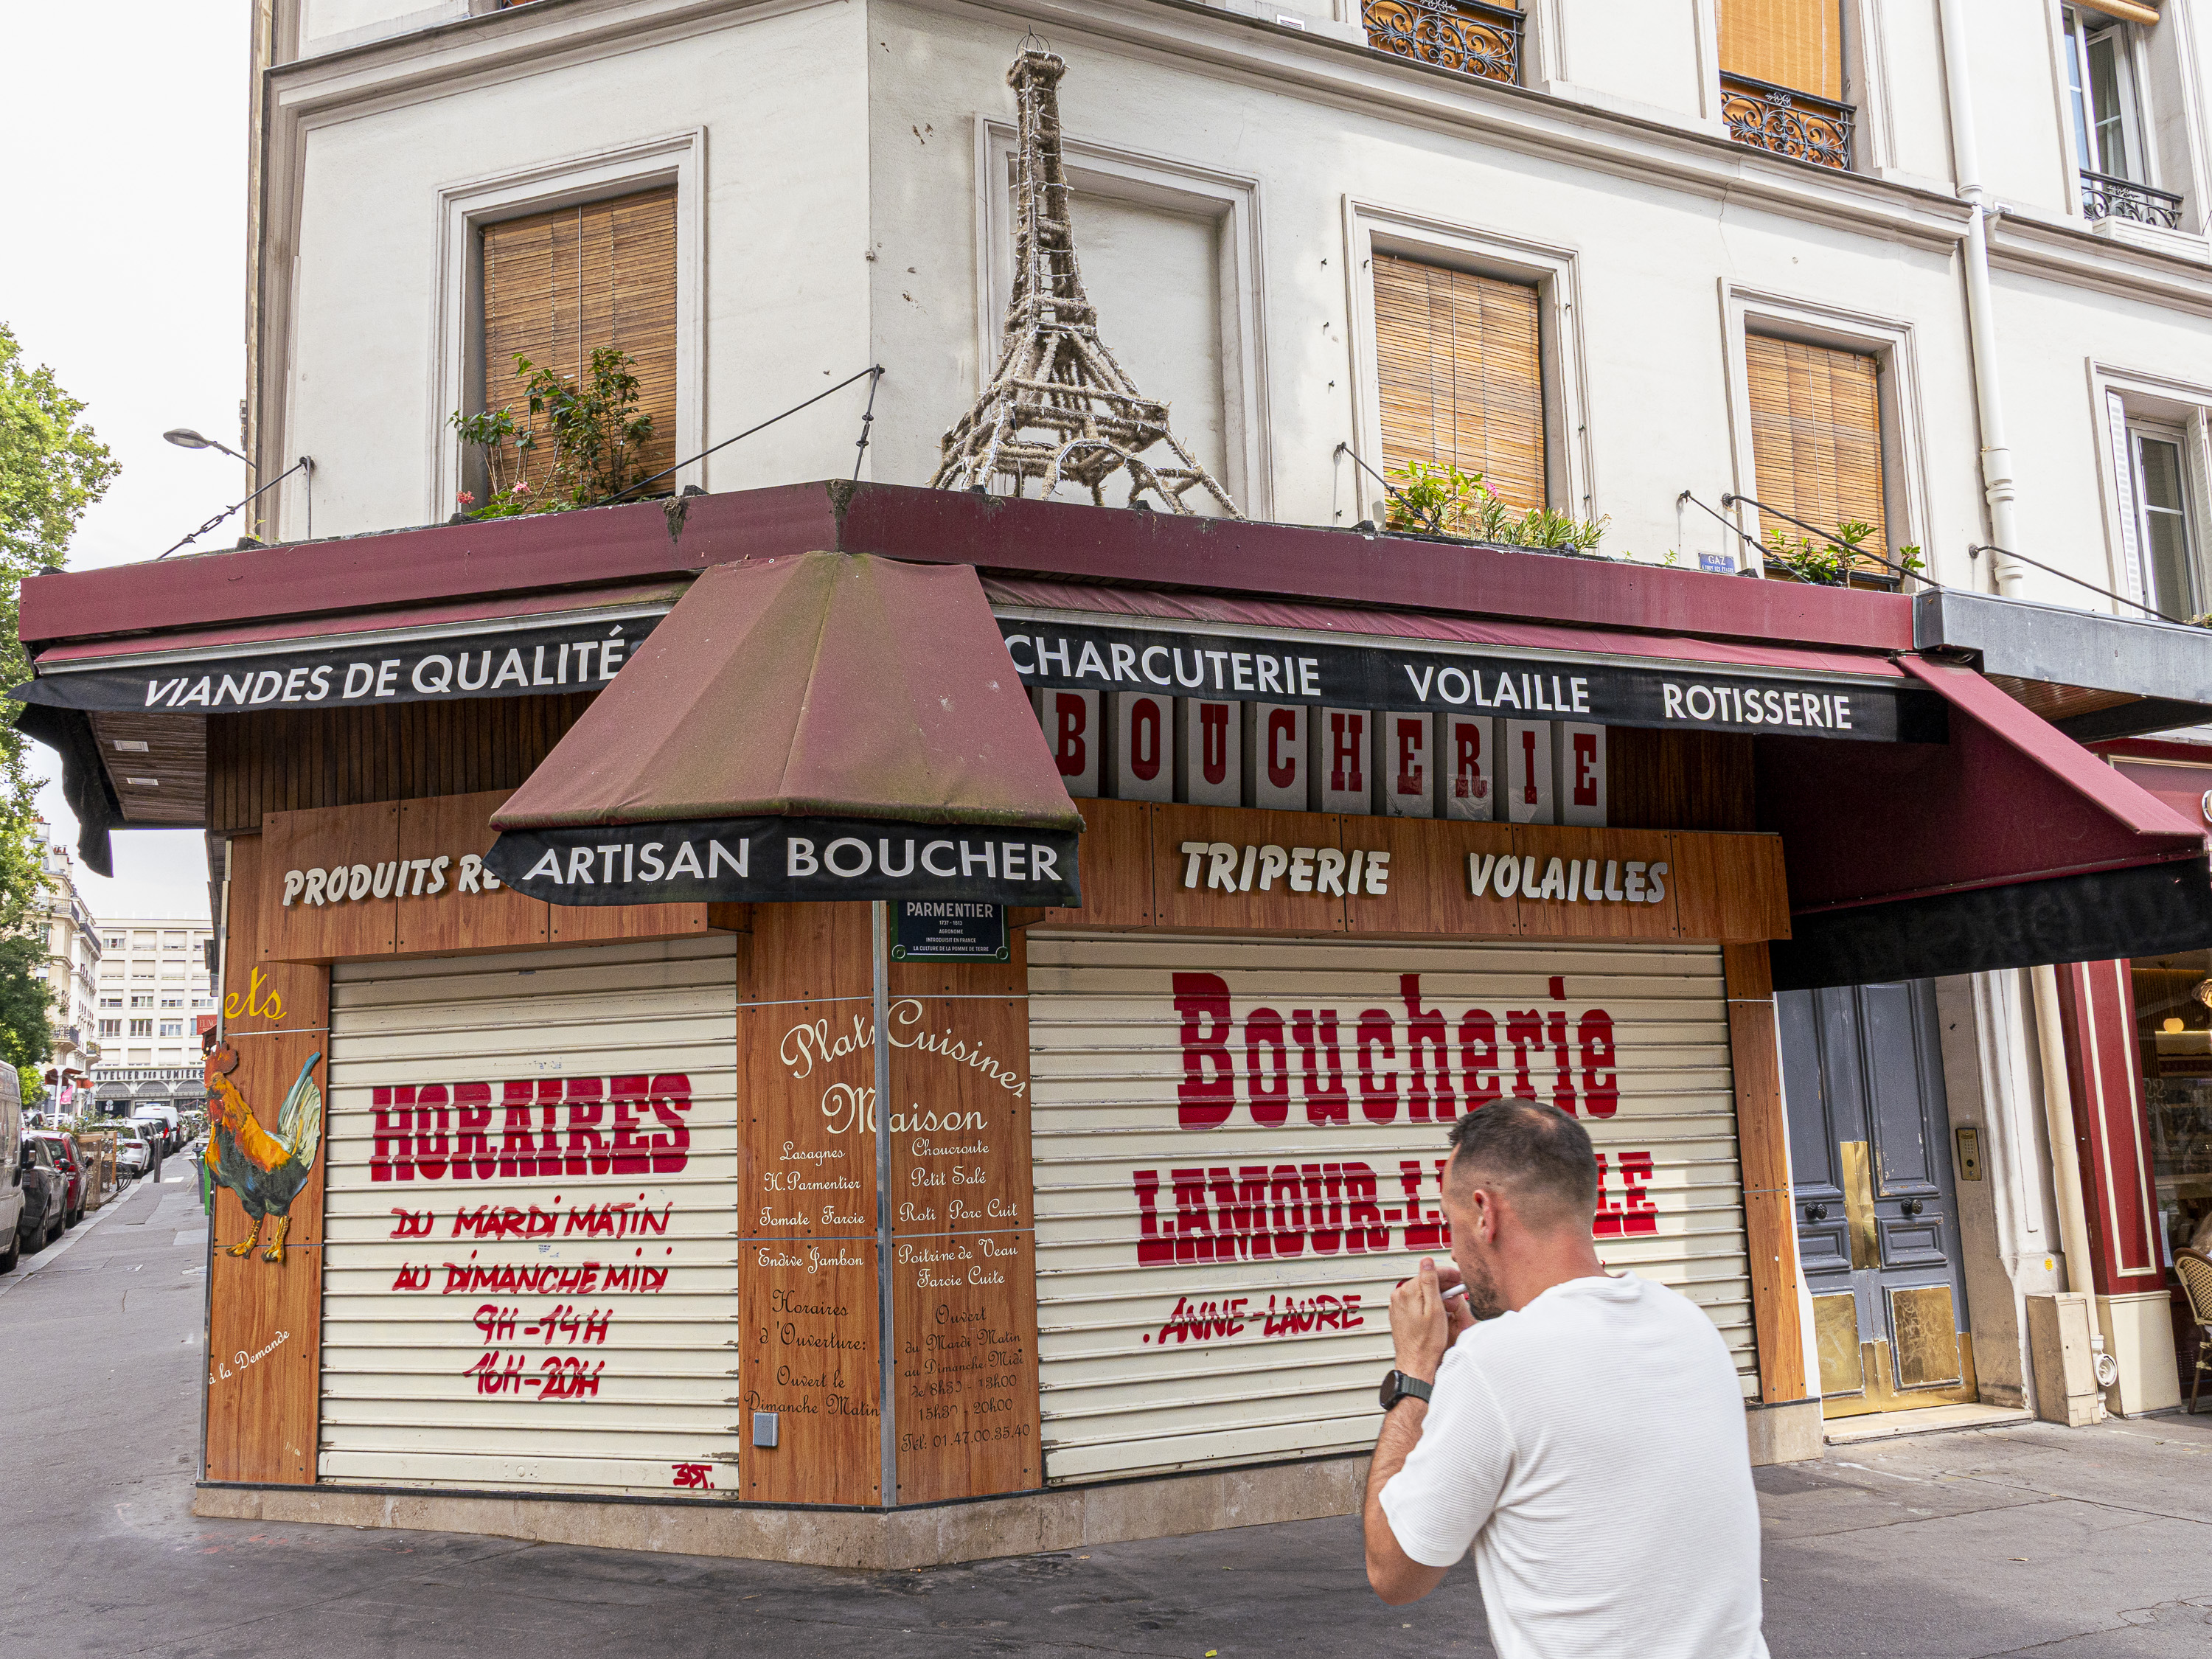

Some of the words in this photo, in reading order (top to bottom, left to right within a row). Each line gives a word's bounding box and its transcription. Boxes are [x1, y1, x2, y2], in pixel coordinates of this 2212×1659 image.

[1708, 555, 1726, 566] GAZ
[145, 664, 333, 708] VIANDES
[344, 658, 402, 698] DE
[411, 625, 625, 695] QUALITÉ
[1004, 633, 1321, 696] CHARCUTERIE
[1404, 664, 1591, 714] VOLAILLE
[1662, 682, 1852, 730] ROTISSERIE
[1054, 692, 1598, 807] BOUCHERIE
[521, 838, 750, 885] ARTISAN
[786, 837, 1062, 881] BOUCHER
[1180, 841, 1391, 897] TRIPERIE
[1470, 852, 1669, 905] VOLAILLES
[282, 855, 450, 907] PRODUITS
[907, 902, 994, 918] PARMENTIER
[1172, 972, 1620, 1130] Boucherie
[96, 1070, 139, 1081] ATELIER
[143, 1071, 156, 1079] DES
[821, 1082, 988, 1135] Maison
[370, 1073, 692, 1182] HORAIRES
[779, 1141, 846, 1166] Lasagnes
[911, 1137, 990, 1157] Choucroute
[911, 1166, 947, 1188] Petit
[952, 1165, 987, 1185] Salé
[389, 1207, 434, 1239] DU
[759, 1206, 810, 1227] Tomate
[821, 1206, 866, 1225] Farcie
[900, 1202, 937, 1222] Roti
[949, 1199, 982, 1220] Porc
[987, 1197, 1018, 1218] Cuit
[758, 1248, 804, 1267] Endive
[807, 1246, 864, 1274] Jambon
[898, 1244, 956, 1265] Poitrine
[957, 1245, 973, 1260] de
[978, 1238, 1018, 1257] Veau
[392, 1262, 431, 1292] AU
[917, 1267, 963, 1288] Farcie
[967, 1265, 1006, 1285] Cuite
[771, 1289, 849, 1316] Horaires
[935, 1304, 987, 1325] Ouvert
[1158, 1293, 1365, 1346] ANNE-LAURE
[905, 1340, 921, 1354] du
[925, 1333, 972, 1352] Mardi
[976, 1328, 1022, 1346] Matin
[219, 1363, 232, 1380] la
[234, 1331, 290, 1371] Demande
[904, 1369, 921, 1377] au
[924, 1355, 984, 1374] Dimanche
[987, 1350, 1024, 1367] Midi
[776, 1365, 827, 1388] Ouvert
[832, 1368, 846, 1388] le
[743, 1390, 819, 1414] Dimanche
[825, 1393, 880, 1416] Matin
[973, 1397, 1013, 1415] 20h00
[933, 1423, 1031, 1448] 01.47.00.35.40
